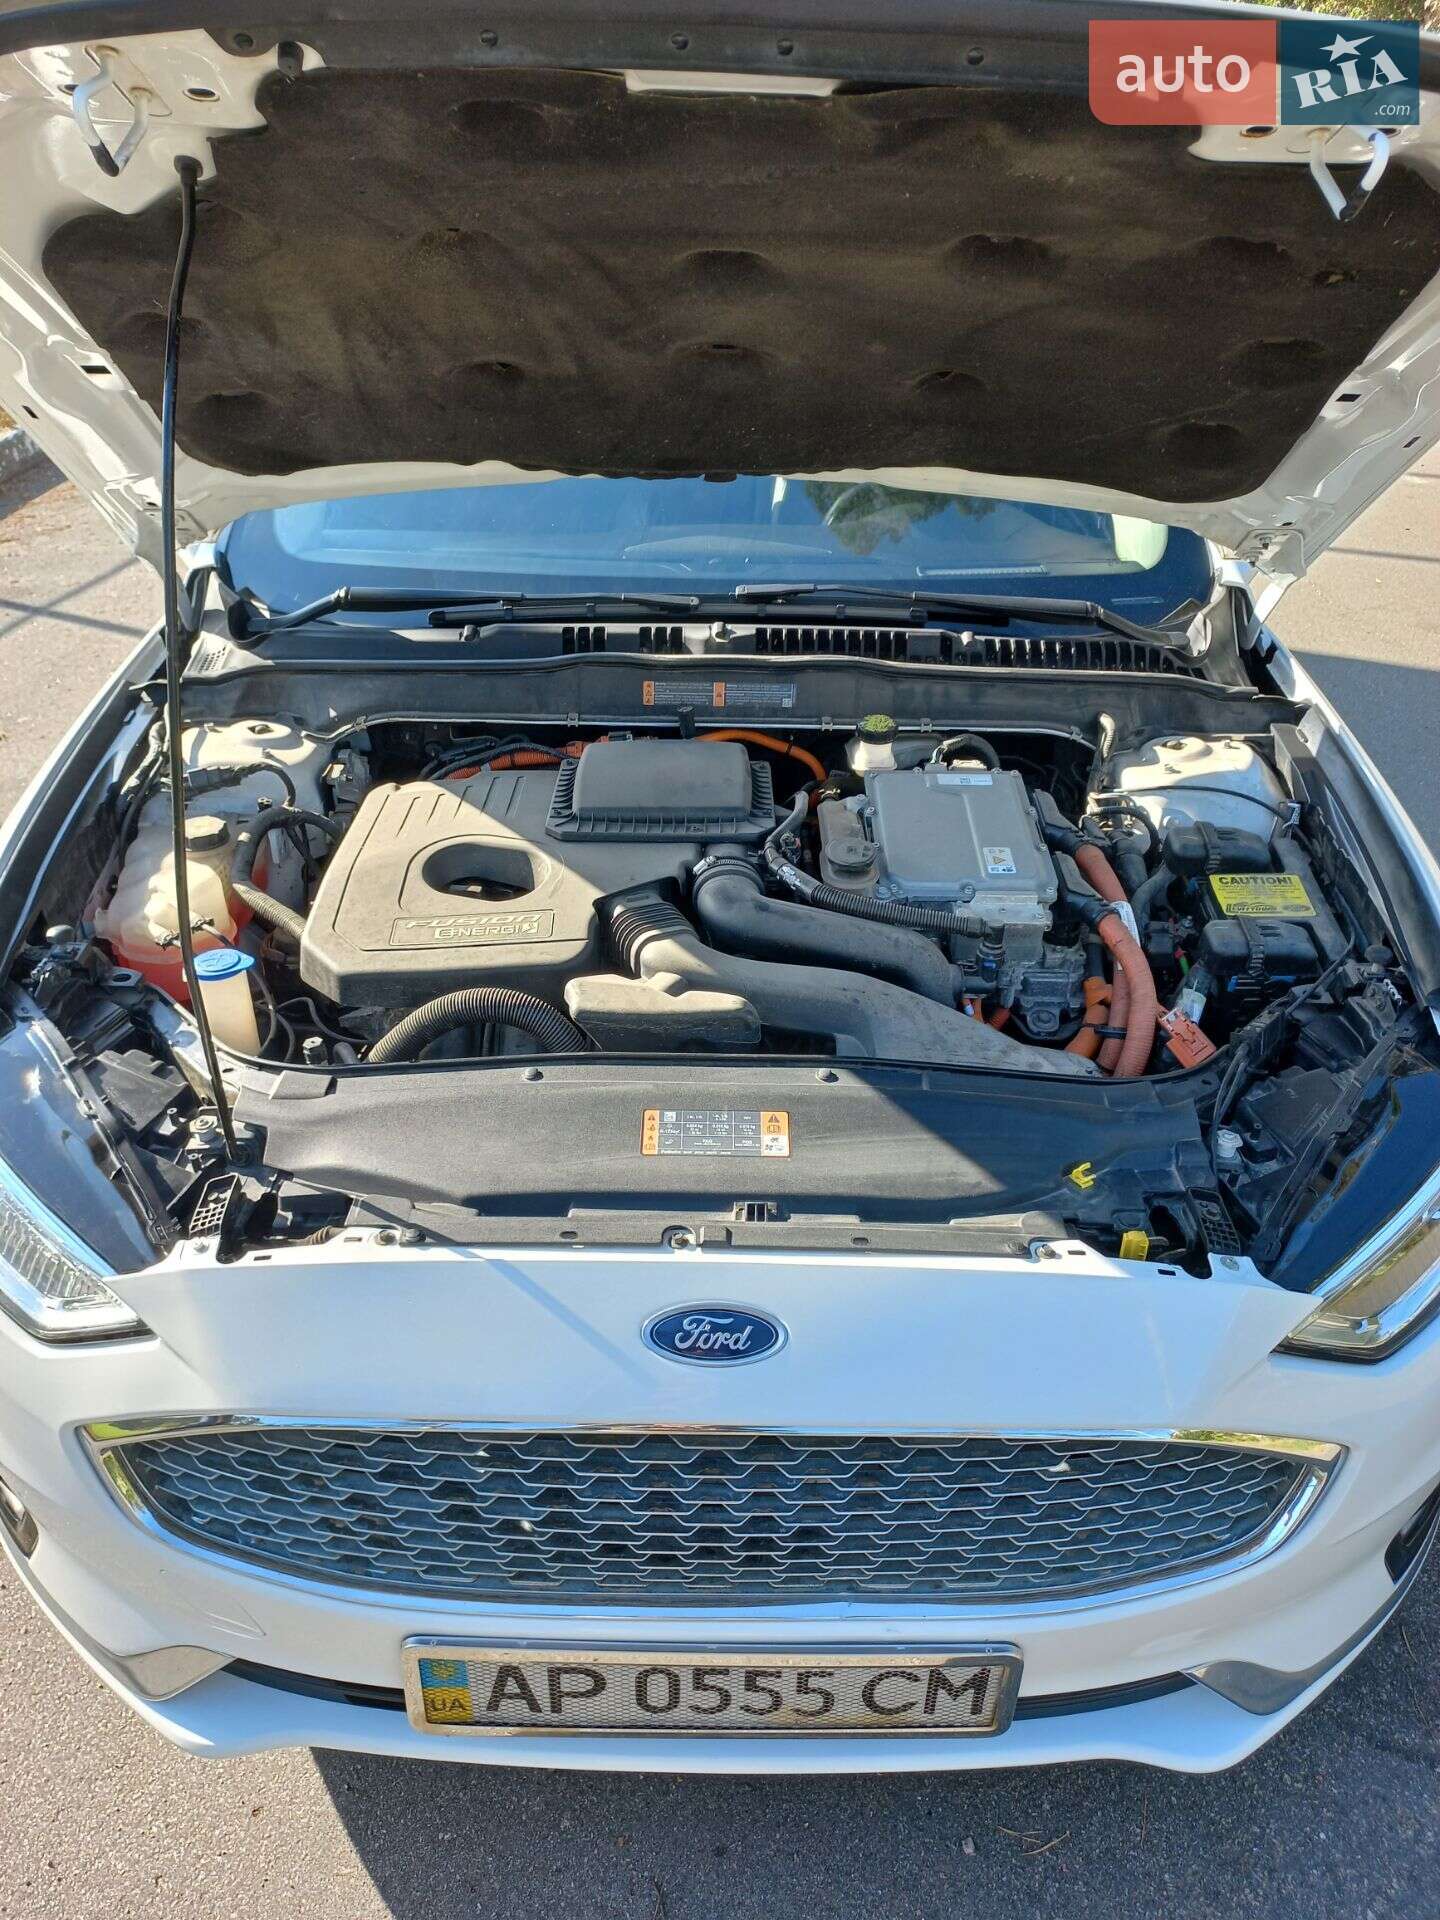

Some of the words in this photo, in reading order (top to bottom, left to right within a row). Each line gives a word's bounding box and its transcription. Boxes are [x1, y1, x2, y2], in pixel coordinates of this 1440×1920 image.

[1218, 876, 1293, 886] CAUTION!
[674, 1316, 754, 1350] Ford
[486, 1664, 607, 1714] AP
[635, 1666, 835, 1717] 0555
[861, 1668, 992, 1716] CM
[429, 1699, 467, 1712] UA
